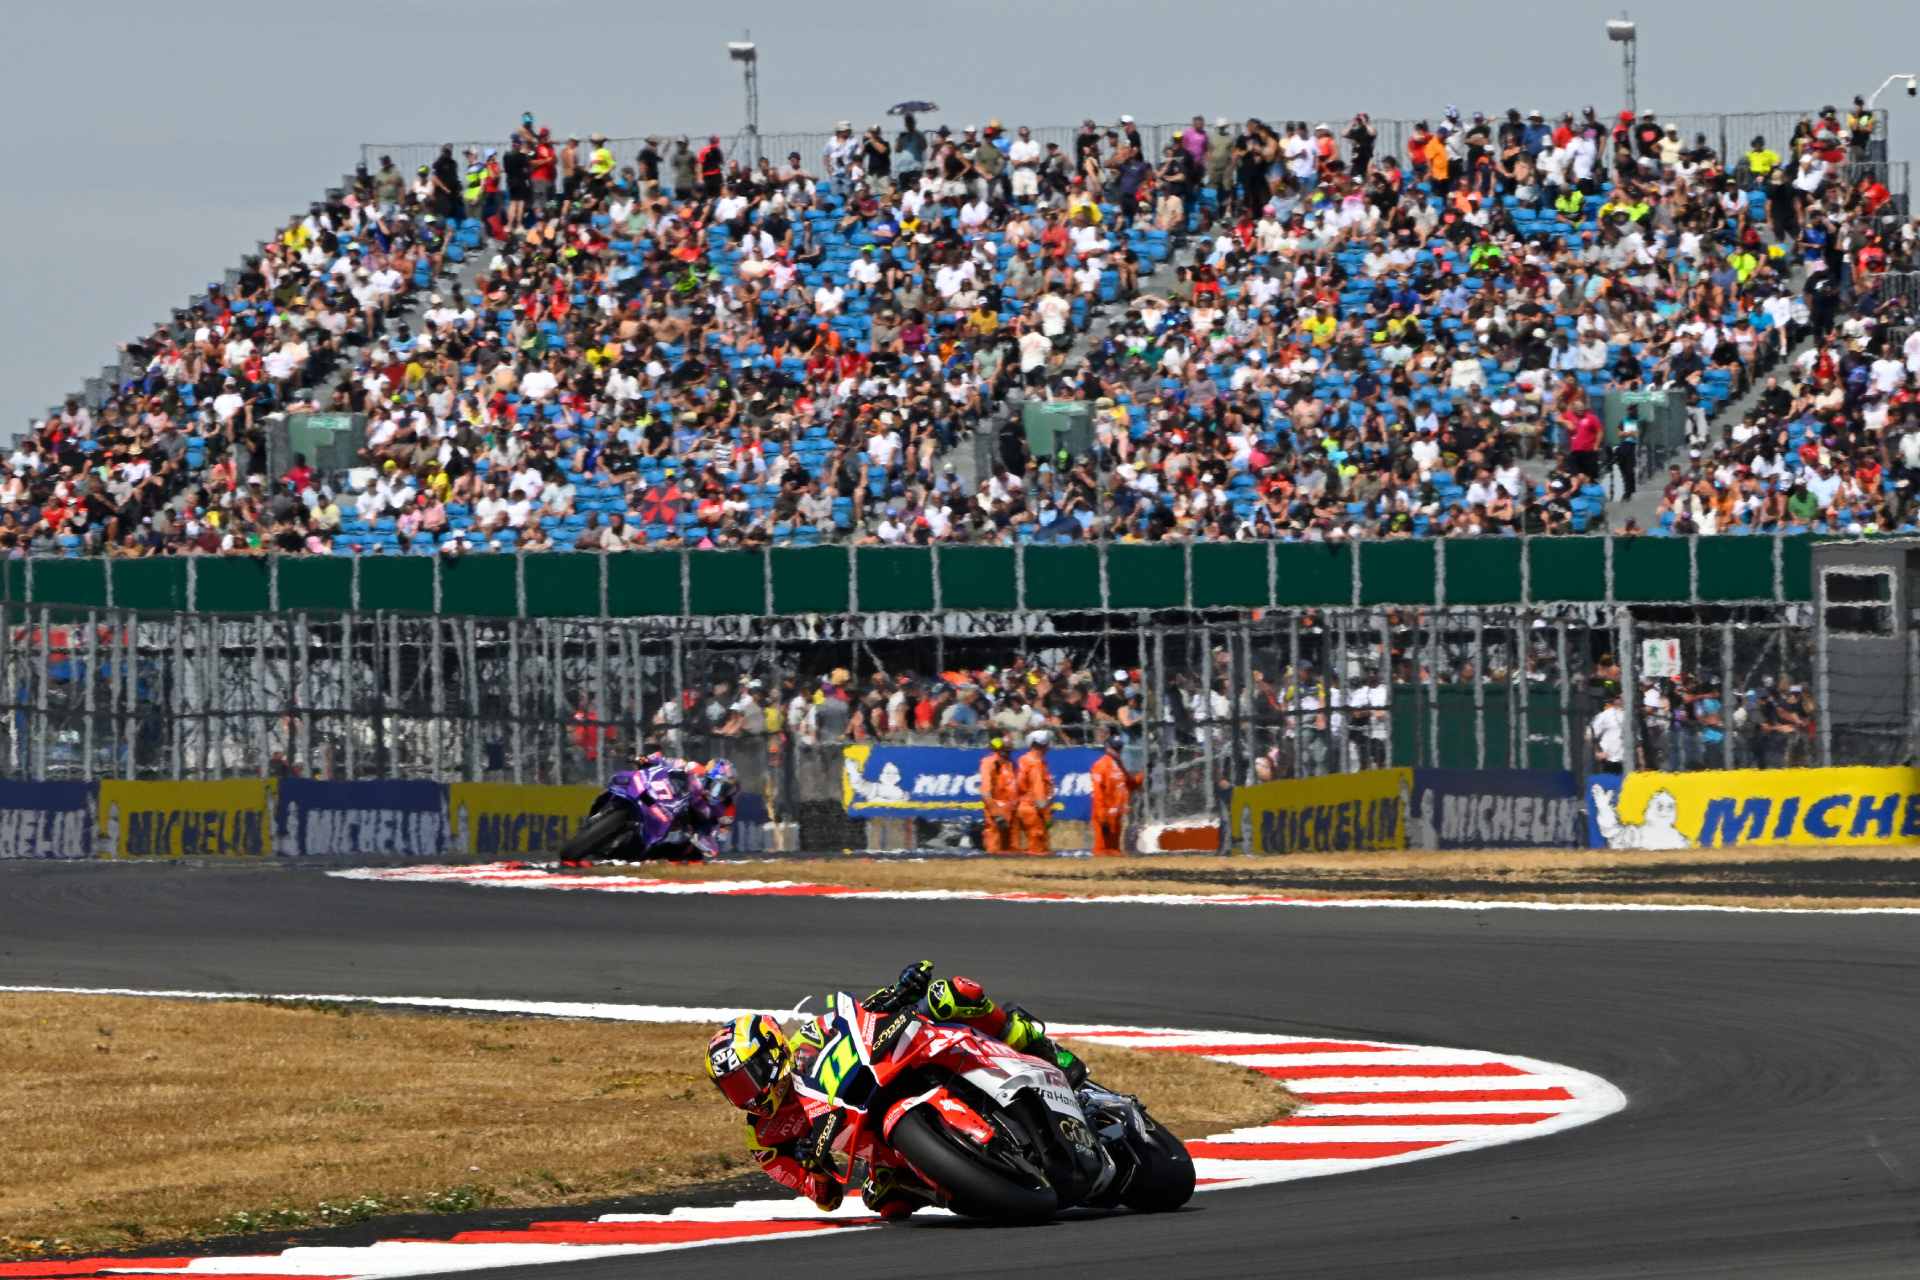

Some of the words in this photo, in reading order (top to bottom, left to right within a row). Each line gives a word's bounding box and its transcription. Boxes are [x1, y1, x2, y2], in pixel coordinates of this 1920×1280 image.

[913, 773, 1093, 796] MICIN
[126, 811, 264, 854] MICHELIN
[305, 809, 442, 854] MICHELIN
[476, 813, 592, 852] MICHEL
[1261, 797, 1401, 852] MICHELIN
[1441, 795, 1585, 842] MICHELIN
